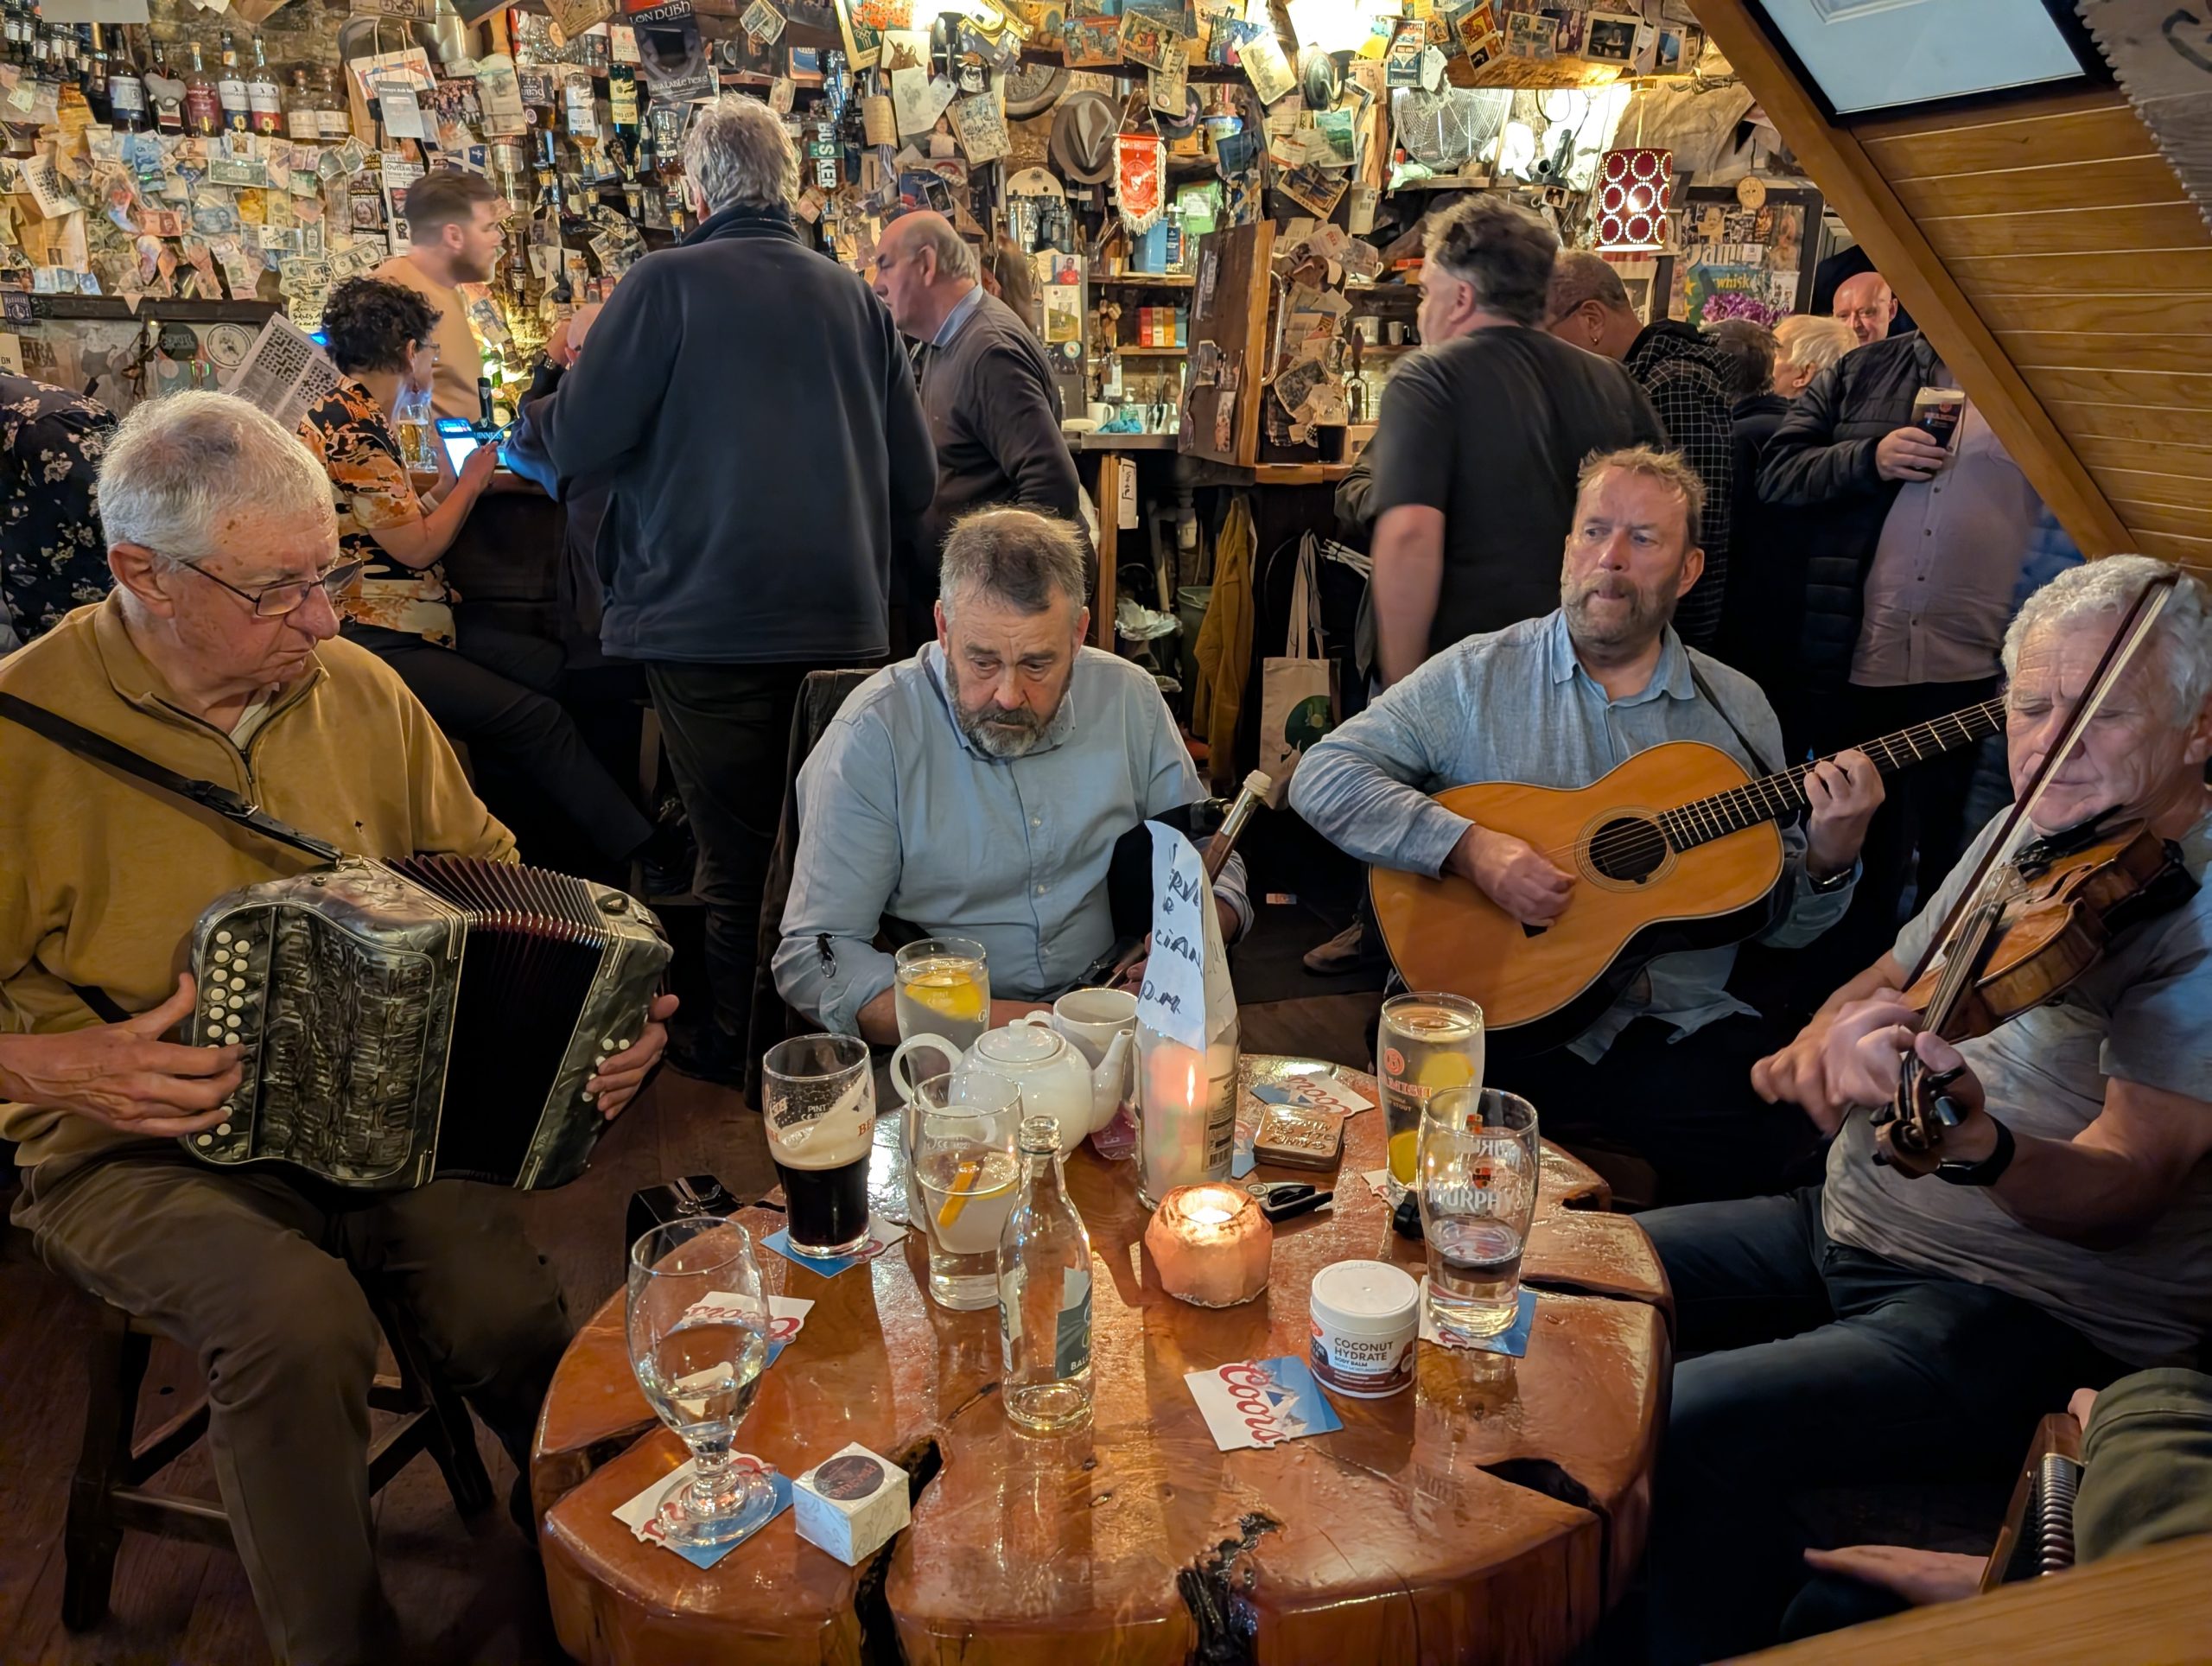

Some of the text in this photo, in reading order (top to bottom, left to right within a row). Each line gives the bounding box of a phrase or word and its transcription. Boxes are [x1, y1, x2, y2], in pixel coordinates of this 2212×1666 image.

[629, 12, 653, 24] LON
[817, 123, 836, 188] BUSKER
[1716, 272, 1751, 289] whisk
[1383, 1074, 1433, 1099] AMISH
[807, 1104, 828, 1114] PINT
[1393, 1102, 1412, 1112] STOUT
[857, 1118, 875, 1137] BE
[1334, 1337, 1394, 1352] COCONUT
[1334, 1346, 1388, 1362] HYDRATE
[1334, 1355, 1349, 1365] BODY
[1219, 1357, 1287, 1444] Coors
